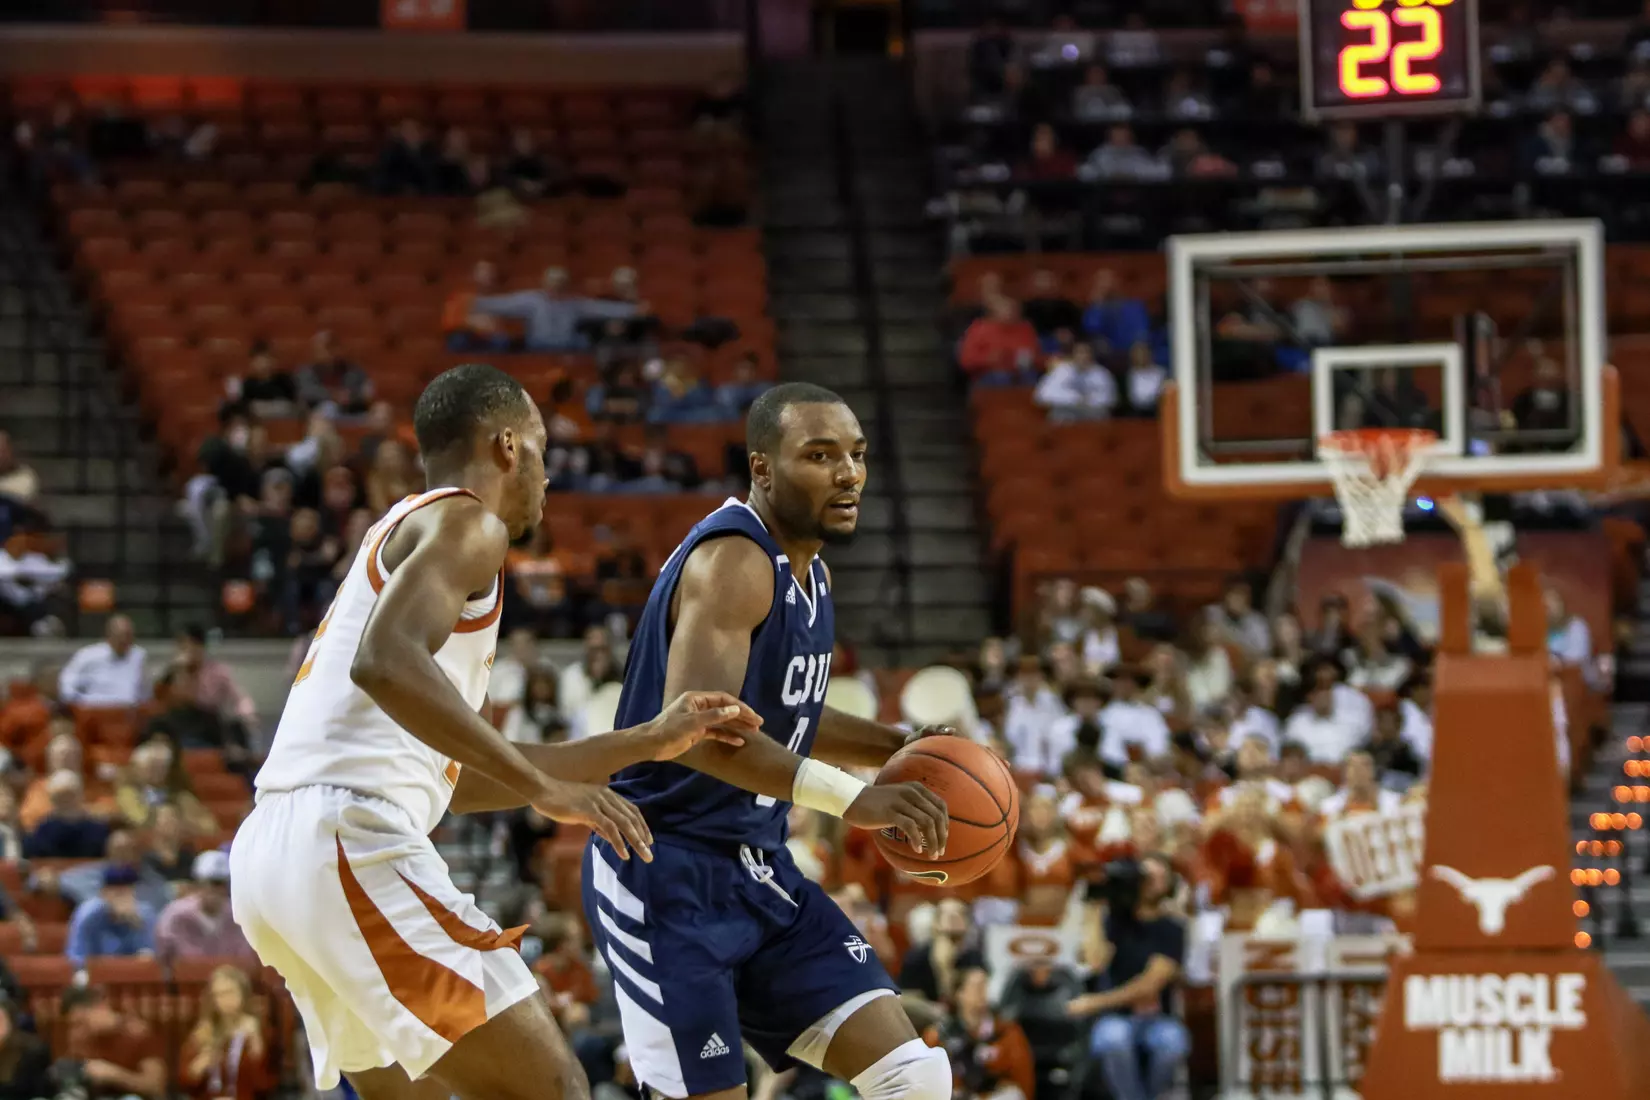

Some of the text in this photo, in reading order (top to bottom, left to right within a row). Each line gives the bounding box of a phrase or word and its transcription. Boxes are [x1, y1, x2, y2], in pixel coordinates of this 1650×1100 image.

[1338, 6, 1442, 98] 22
[1405, 973, 1587, 1031] MUSCLE
[700, 1045, 730, 1059] adidas
[1439, 1026, 1553, 1084] MILK
